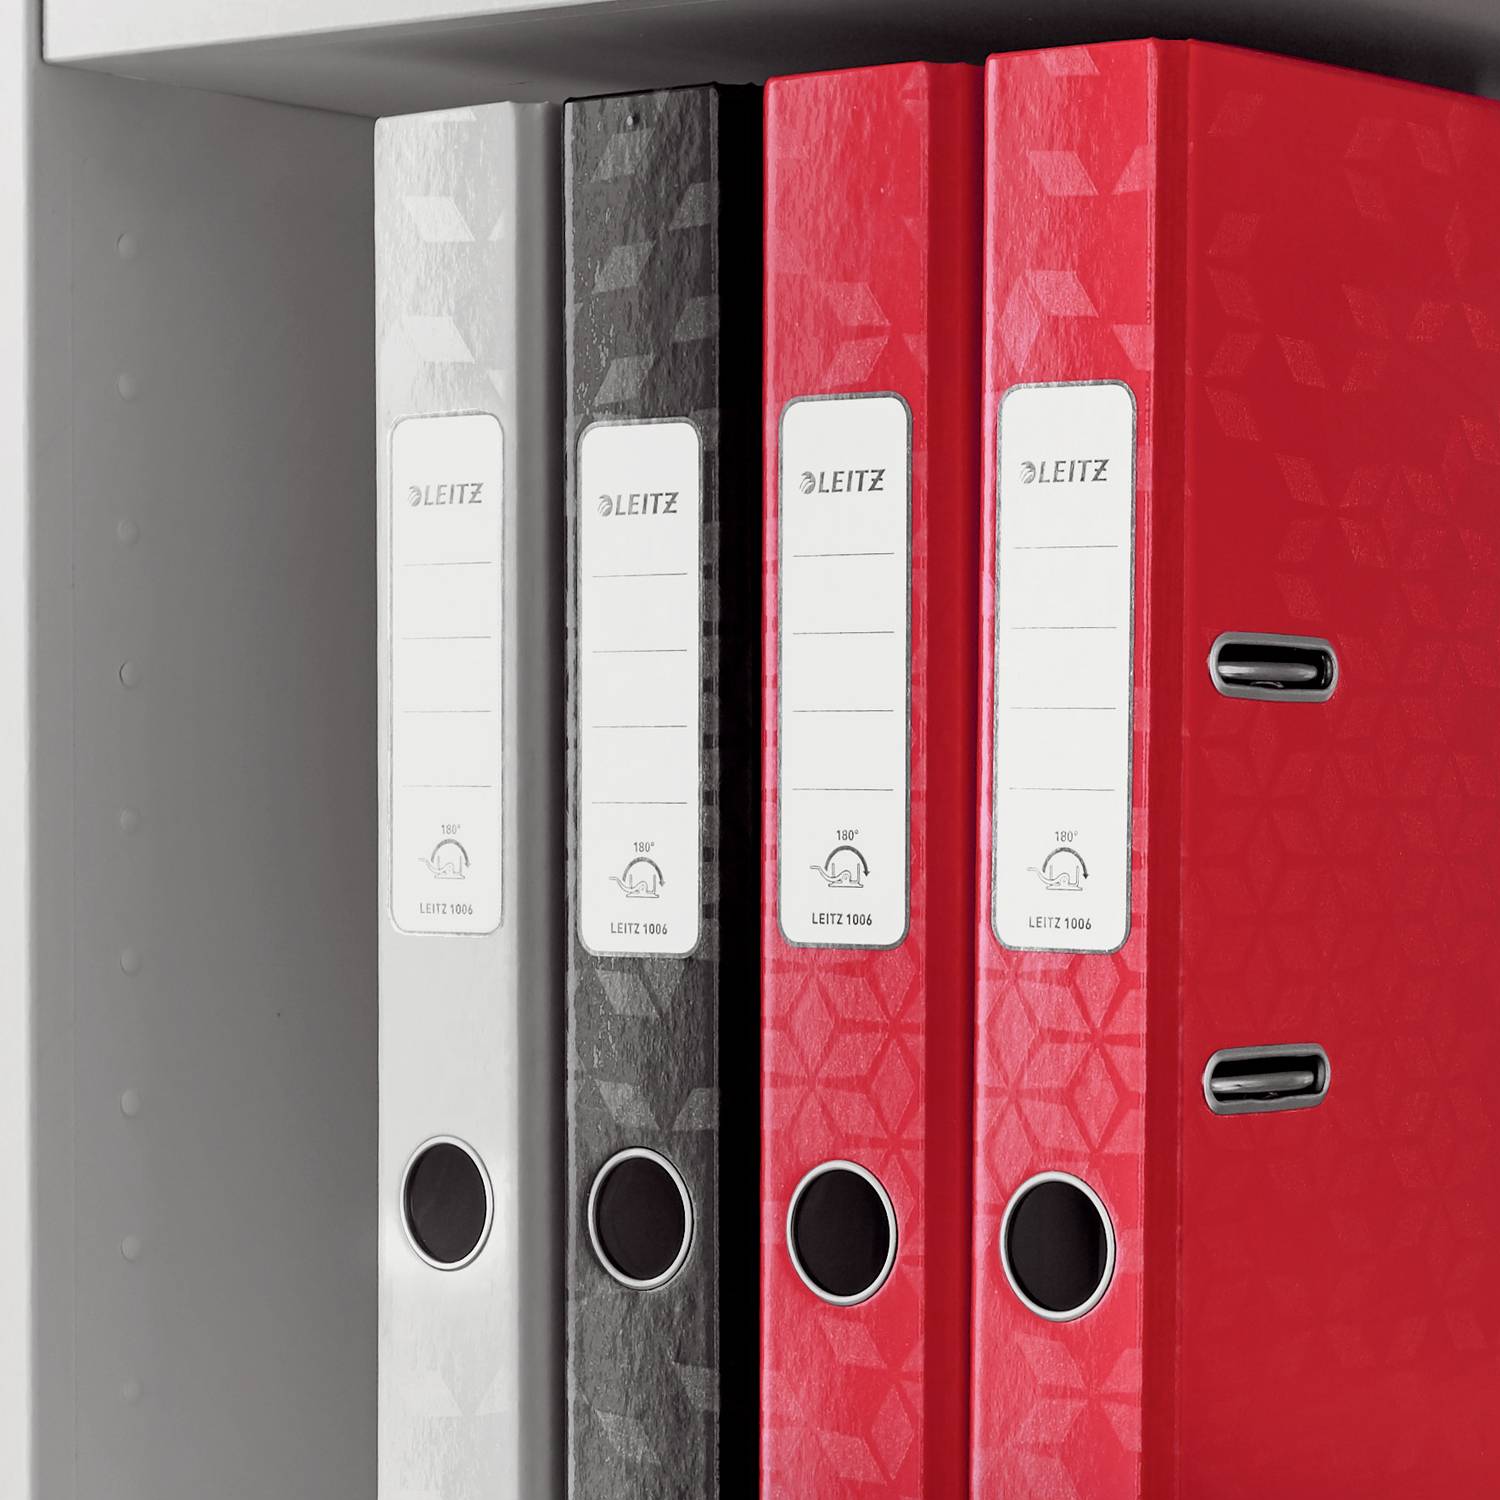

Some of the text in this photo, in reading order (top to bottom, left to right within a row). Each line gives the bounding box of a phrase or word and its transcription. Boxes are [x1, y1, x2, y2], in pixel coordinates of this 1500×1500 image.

[1039, 459, 1110, 483] LEITZ
[818, 469, 886, 493] LEITZ
[423, 483, 484, 506] LEITZ
[615, 491, 680, 515] LEITZ
[420, 903, 473, 915] LEITZ 1006
[812, 912, 872, 926] LEITZ 1006
[1028, 916, 1092, 930] LEITZ 1006
[610, 922, 668, 935] LEITZ 1006
